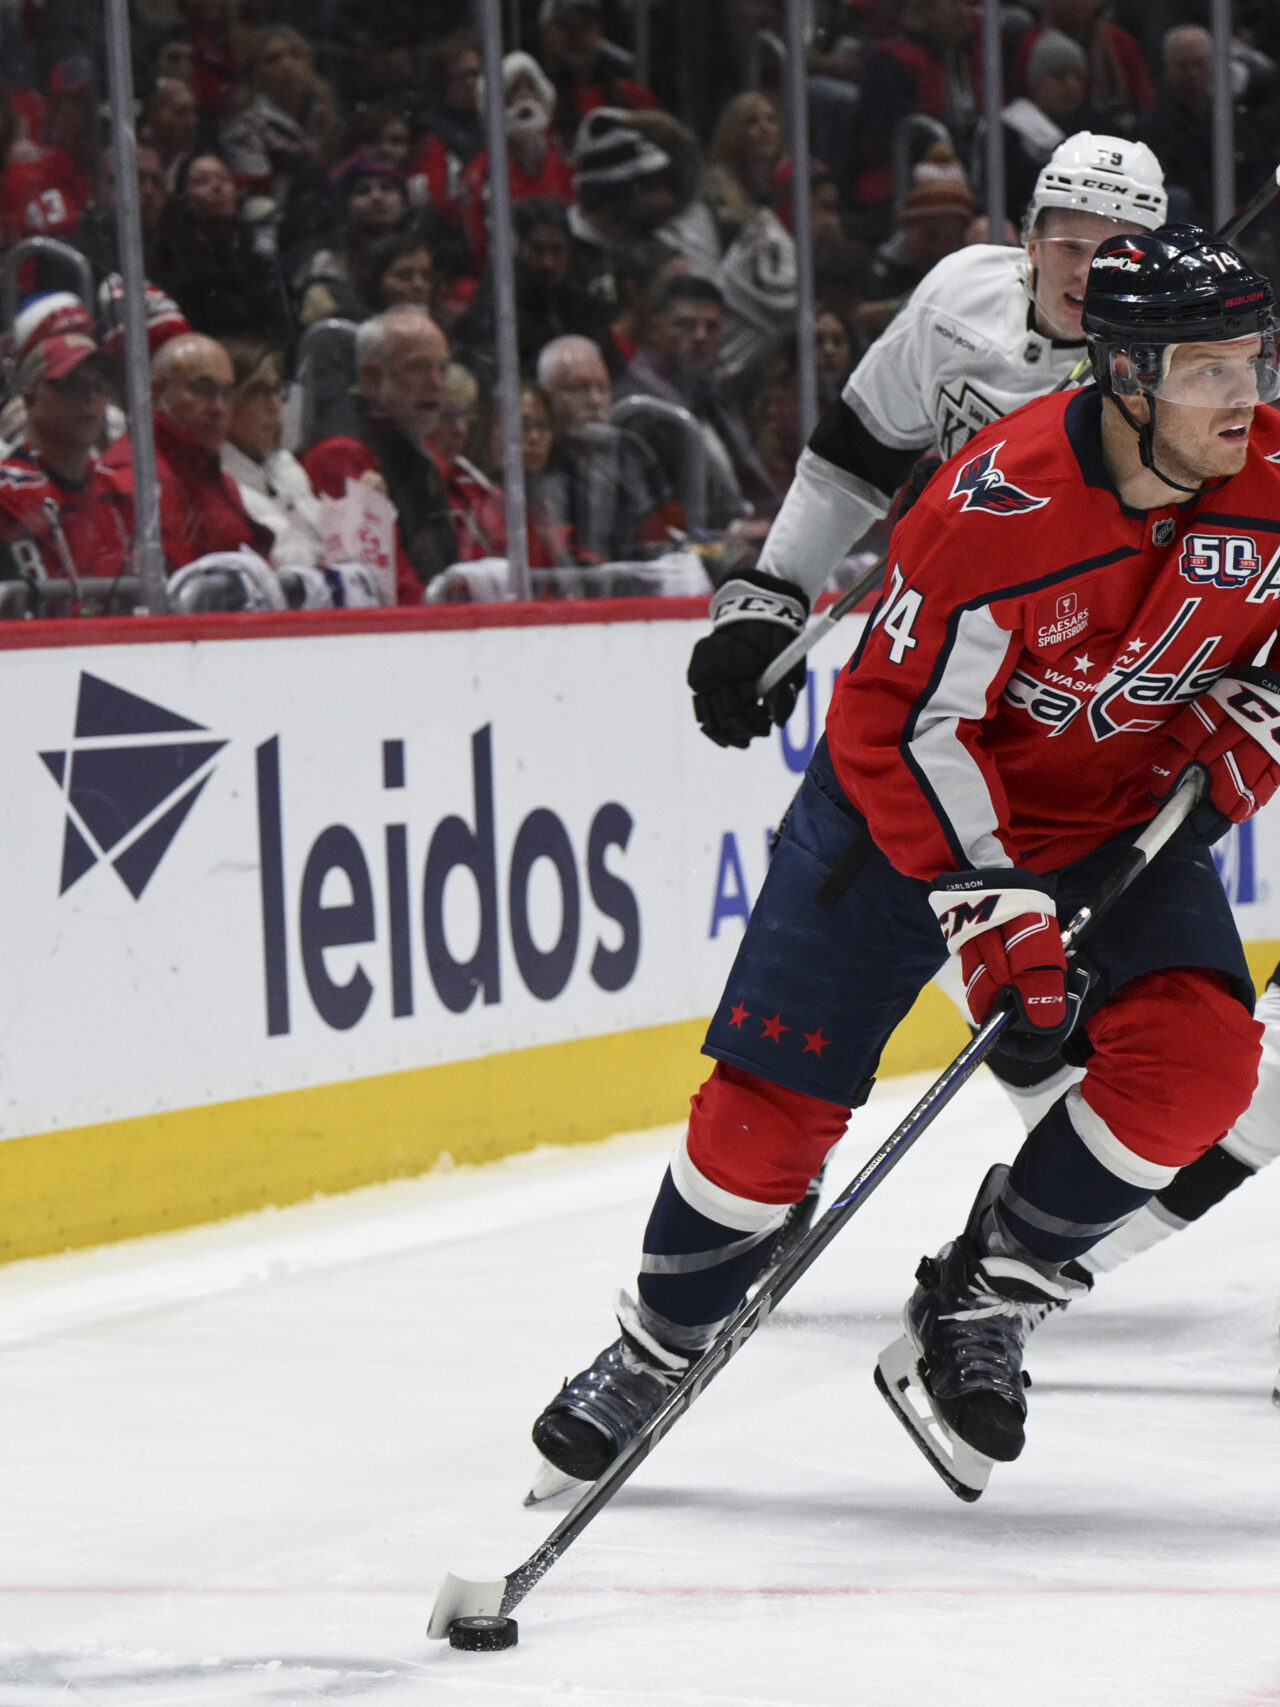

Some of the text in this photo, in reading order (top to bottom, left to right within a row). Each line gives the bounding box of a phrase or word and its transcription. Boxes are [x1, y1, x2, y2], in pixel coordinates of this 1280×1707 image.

[1081, 178, 1130, 195] CCM
[1202, 251, 1244, 274] 74
[1190, 537, 1255, 578] 50
[1037, 608, 1091, 638] CAESARS
[256, 721, 641, 1037] leidos
[946, 880, 984, 892] CARLSON
[1027, 996, 1064, 1005] CCM
